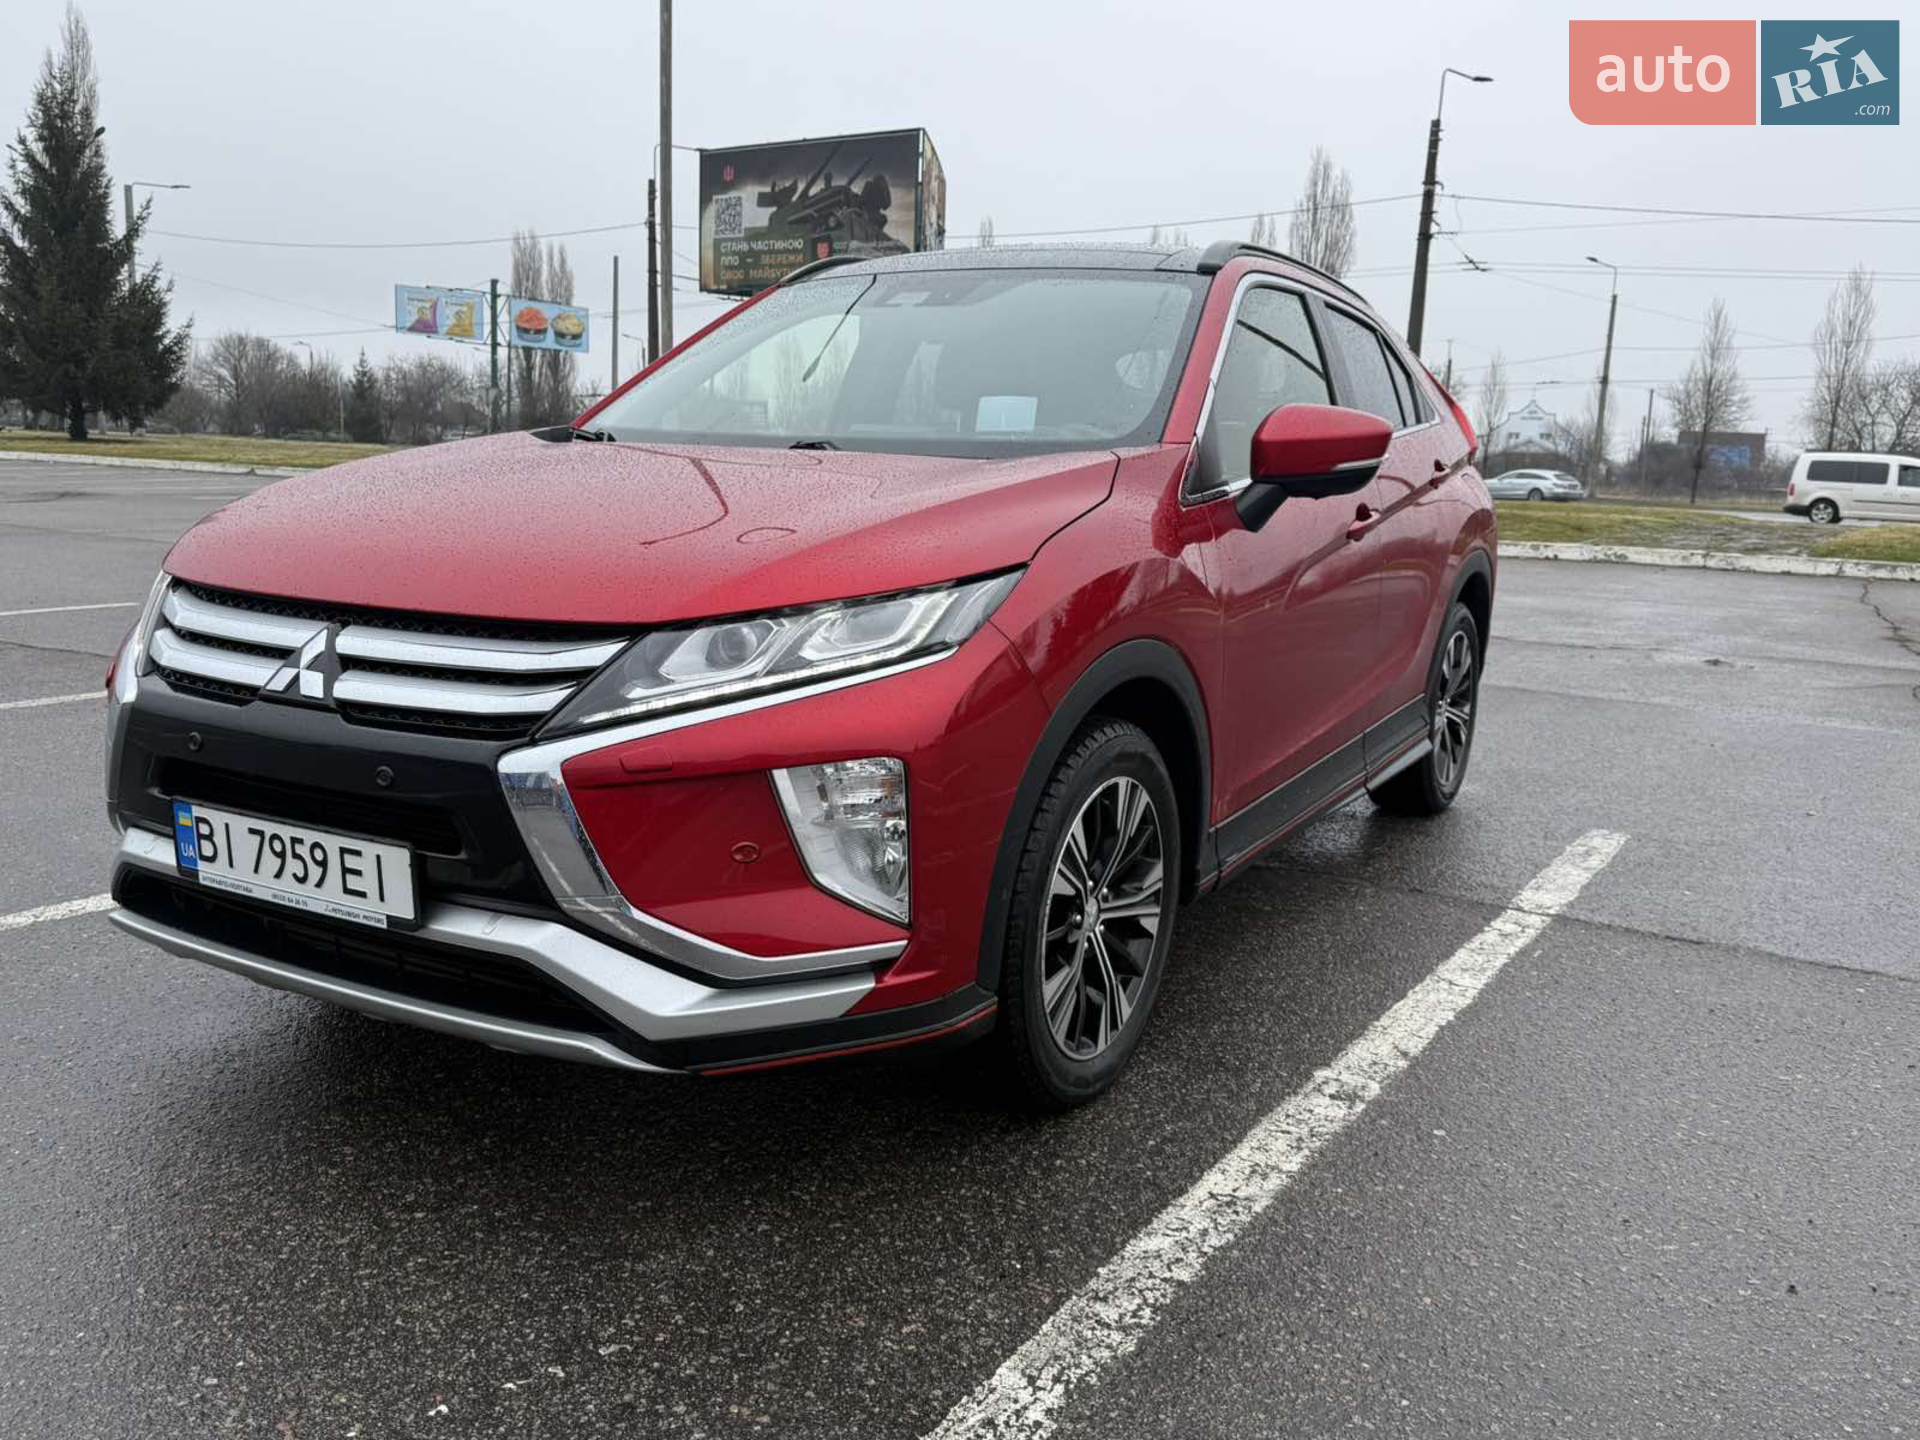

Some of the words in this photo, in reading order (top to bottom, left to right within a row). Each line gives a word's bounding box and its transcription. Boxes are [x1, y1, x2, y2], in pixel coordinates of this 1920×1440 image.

[720, 241, 749, 252] СТАНЬ
[750, 238, 804, 250] ЧАСТИНОЮ
[720, 256, 740, 266] ППО
[180, 842, 196, 858] UA
[195, 816, 234, 869] BI
[248, 827, 329, 889] 7959
[338, 846, 385, 903] EI
